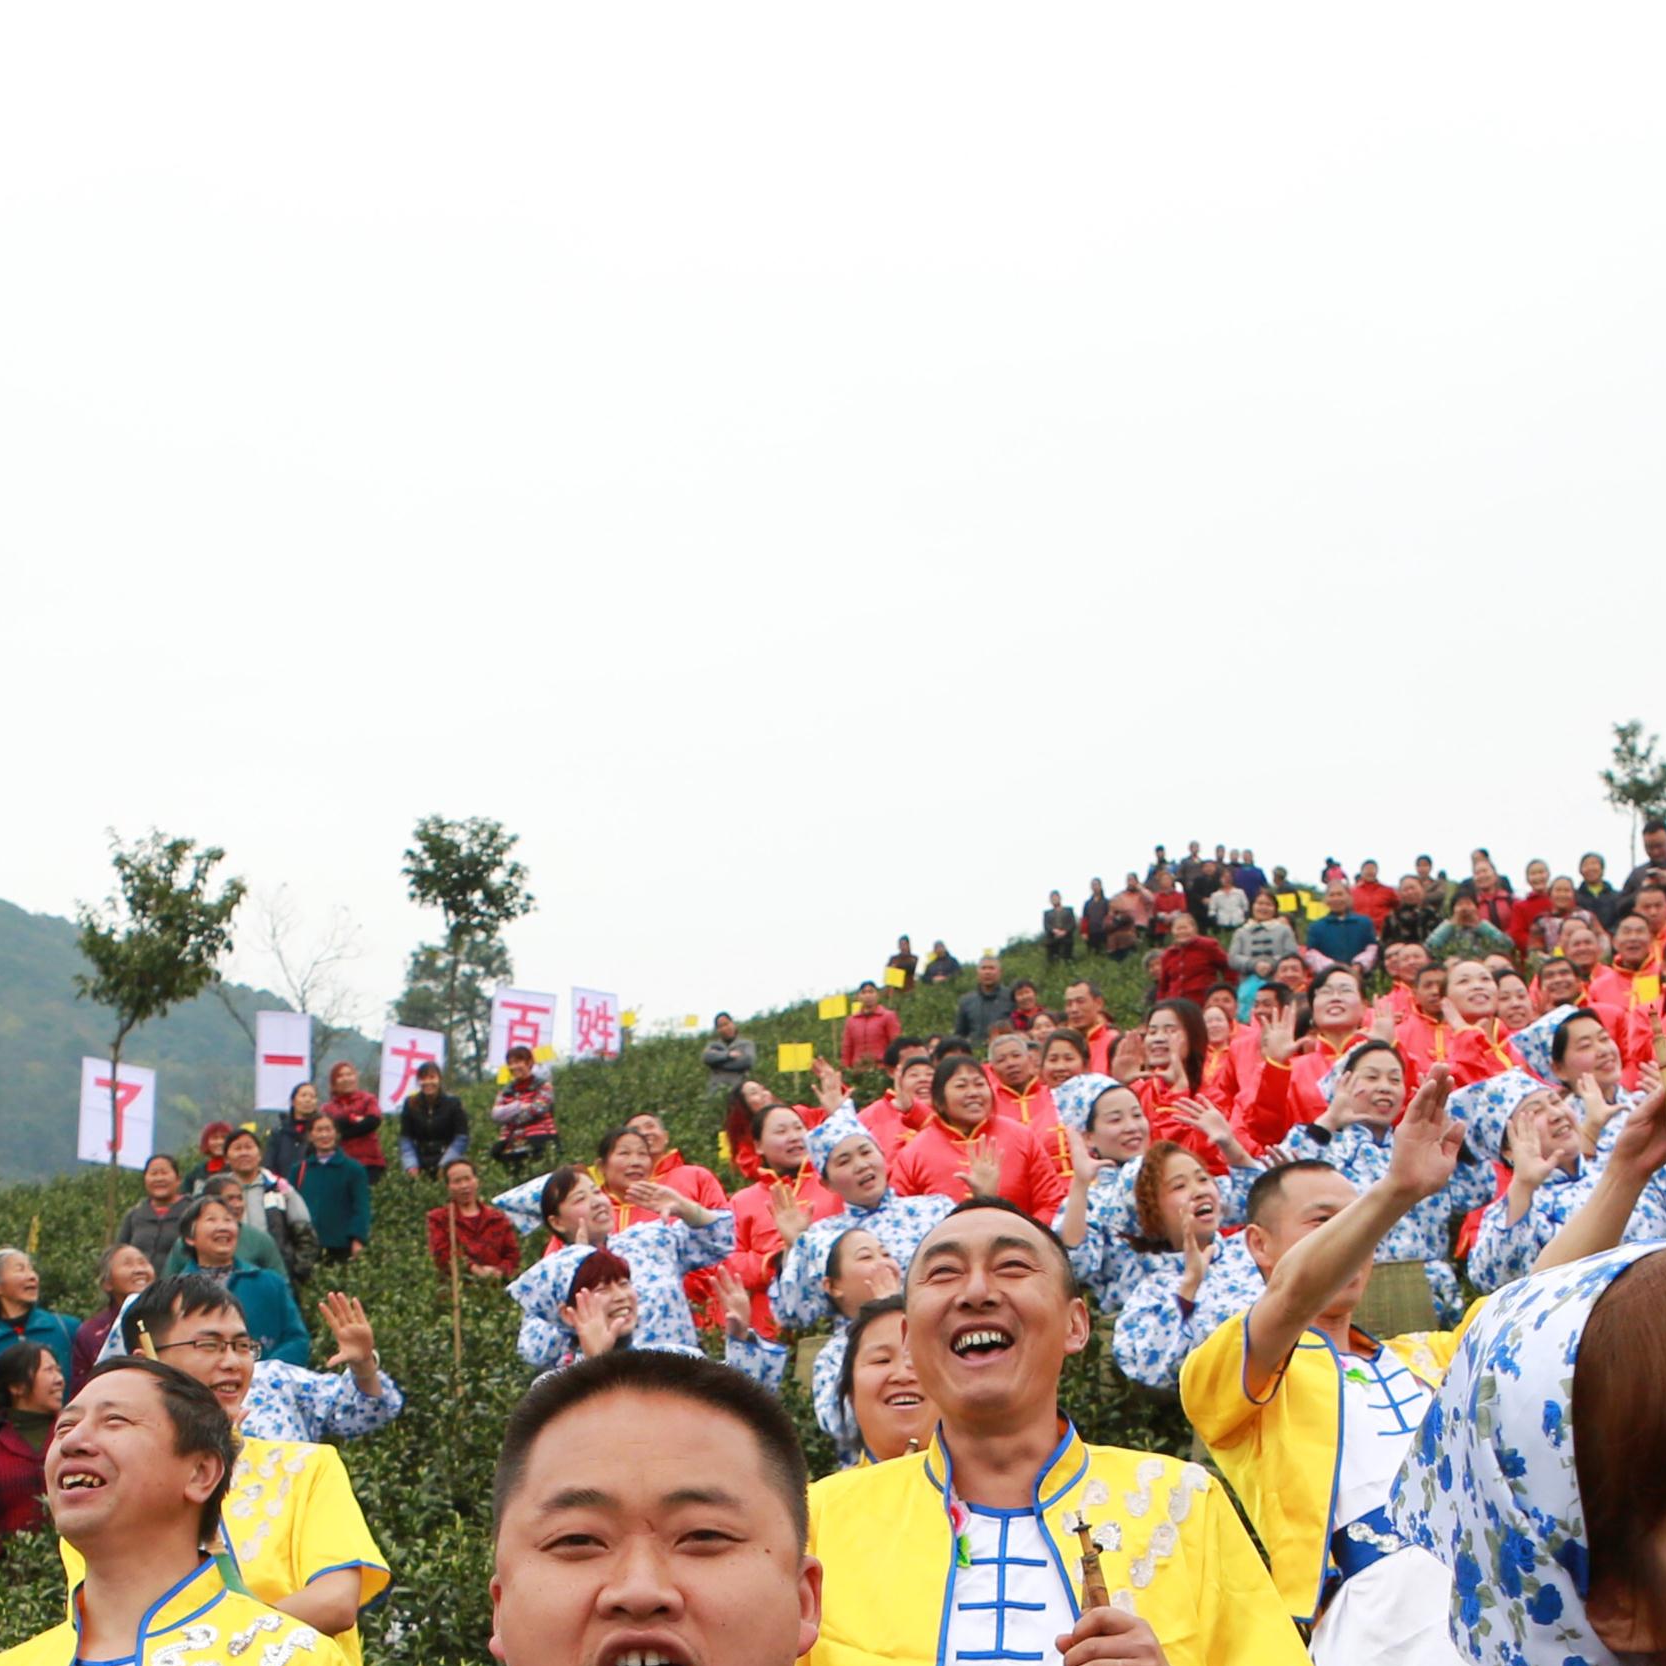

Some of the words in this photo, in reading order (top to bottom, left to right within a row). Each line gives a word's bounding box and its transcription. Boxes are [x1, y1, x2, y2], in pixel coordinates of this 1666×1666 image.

[576, 997, 618, 1058] 姓
[263, 1054, 305, 1067] 一
[94, 1076, 142, 1151] 了
